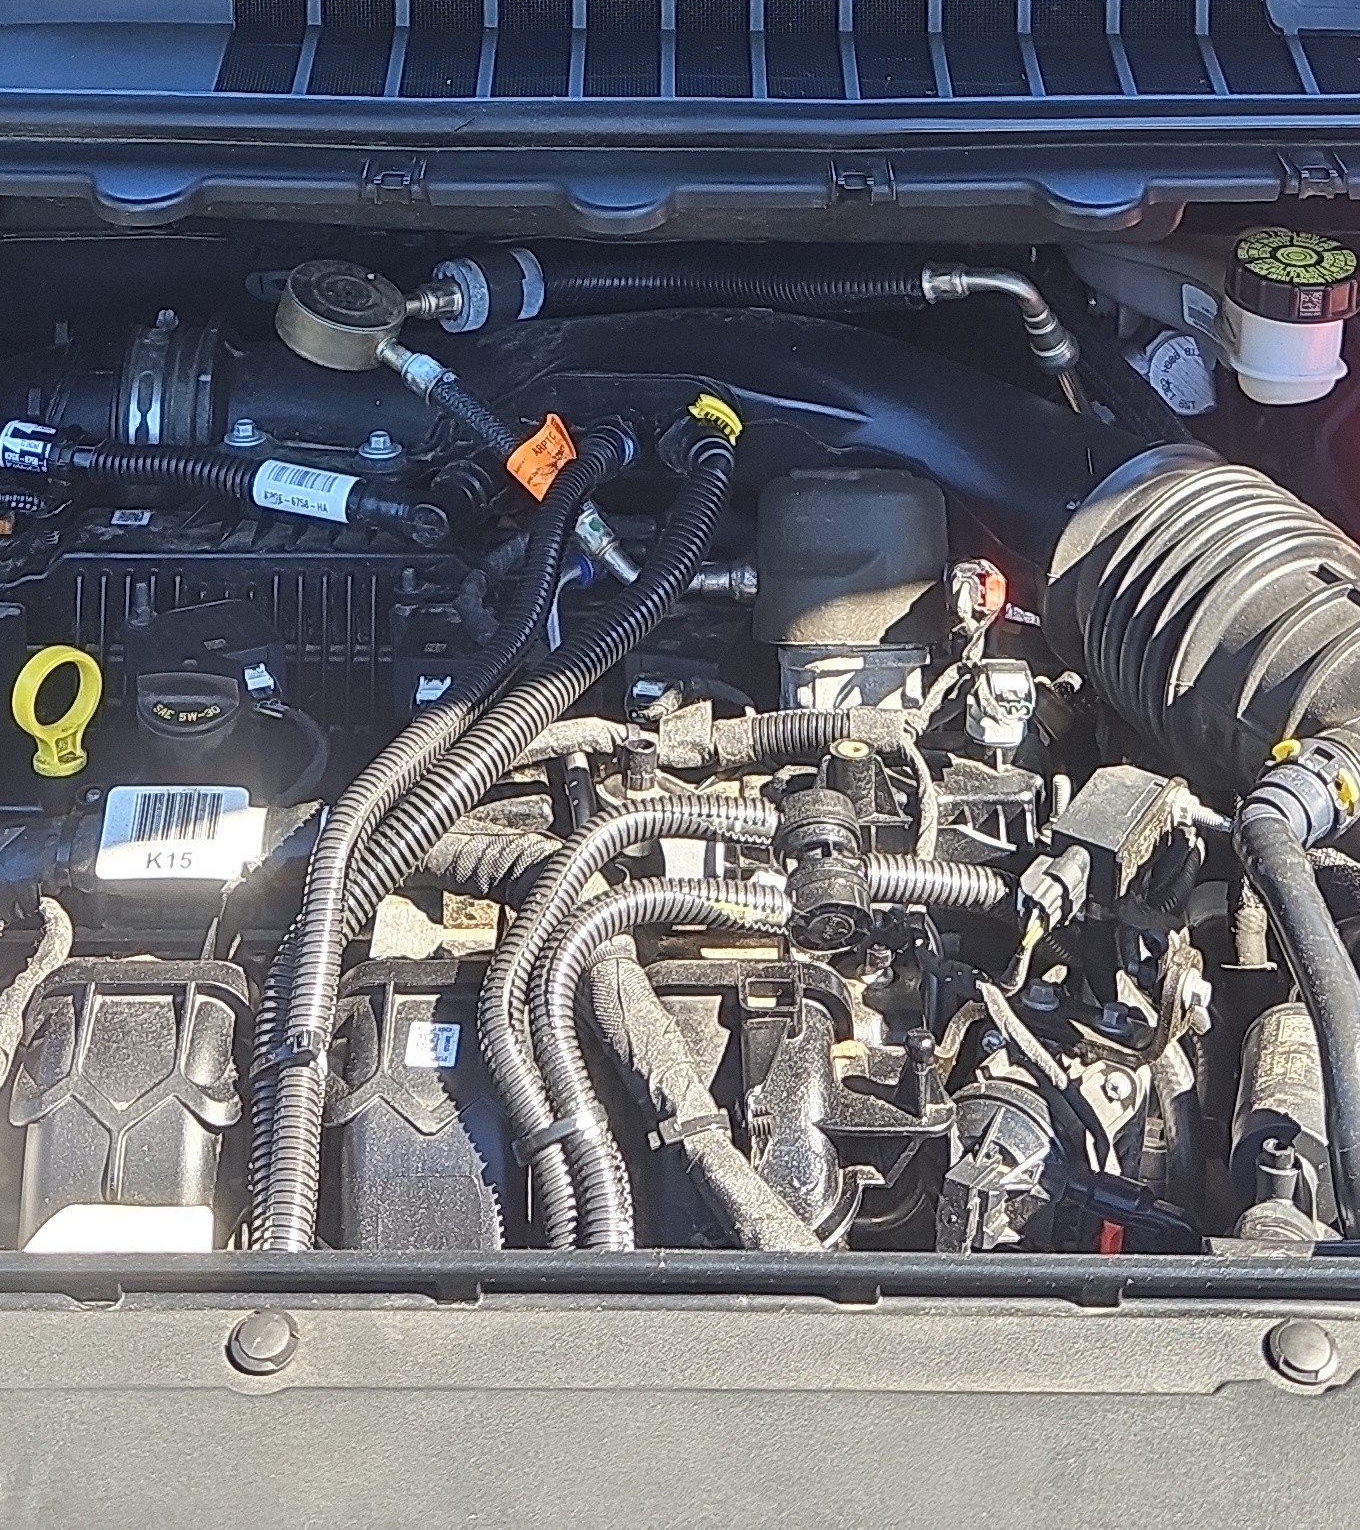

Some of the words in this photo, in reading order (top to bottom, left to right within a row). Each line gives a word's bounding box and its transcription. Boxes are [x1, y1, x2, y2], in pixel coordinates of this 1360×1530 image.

[152, 703, 175, 720] SAE
[178, 705, 221, 722] 5W-30
[145, 852, 193, 869] K15
